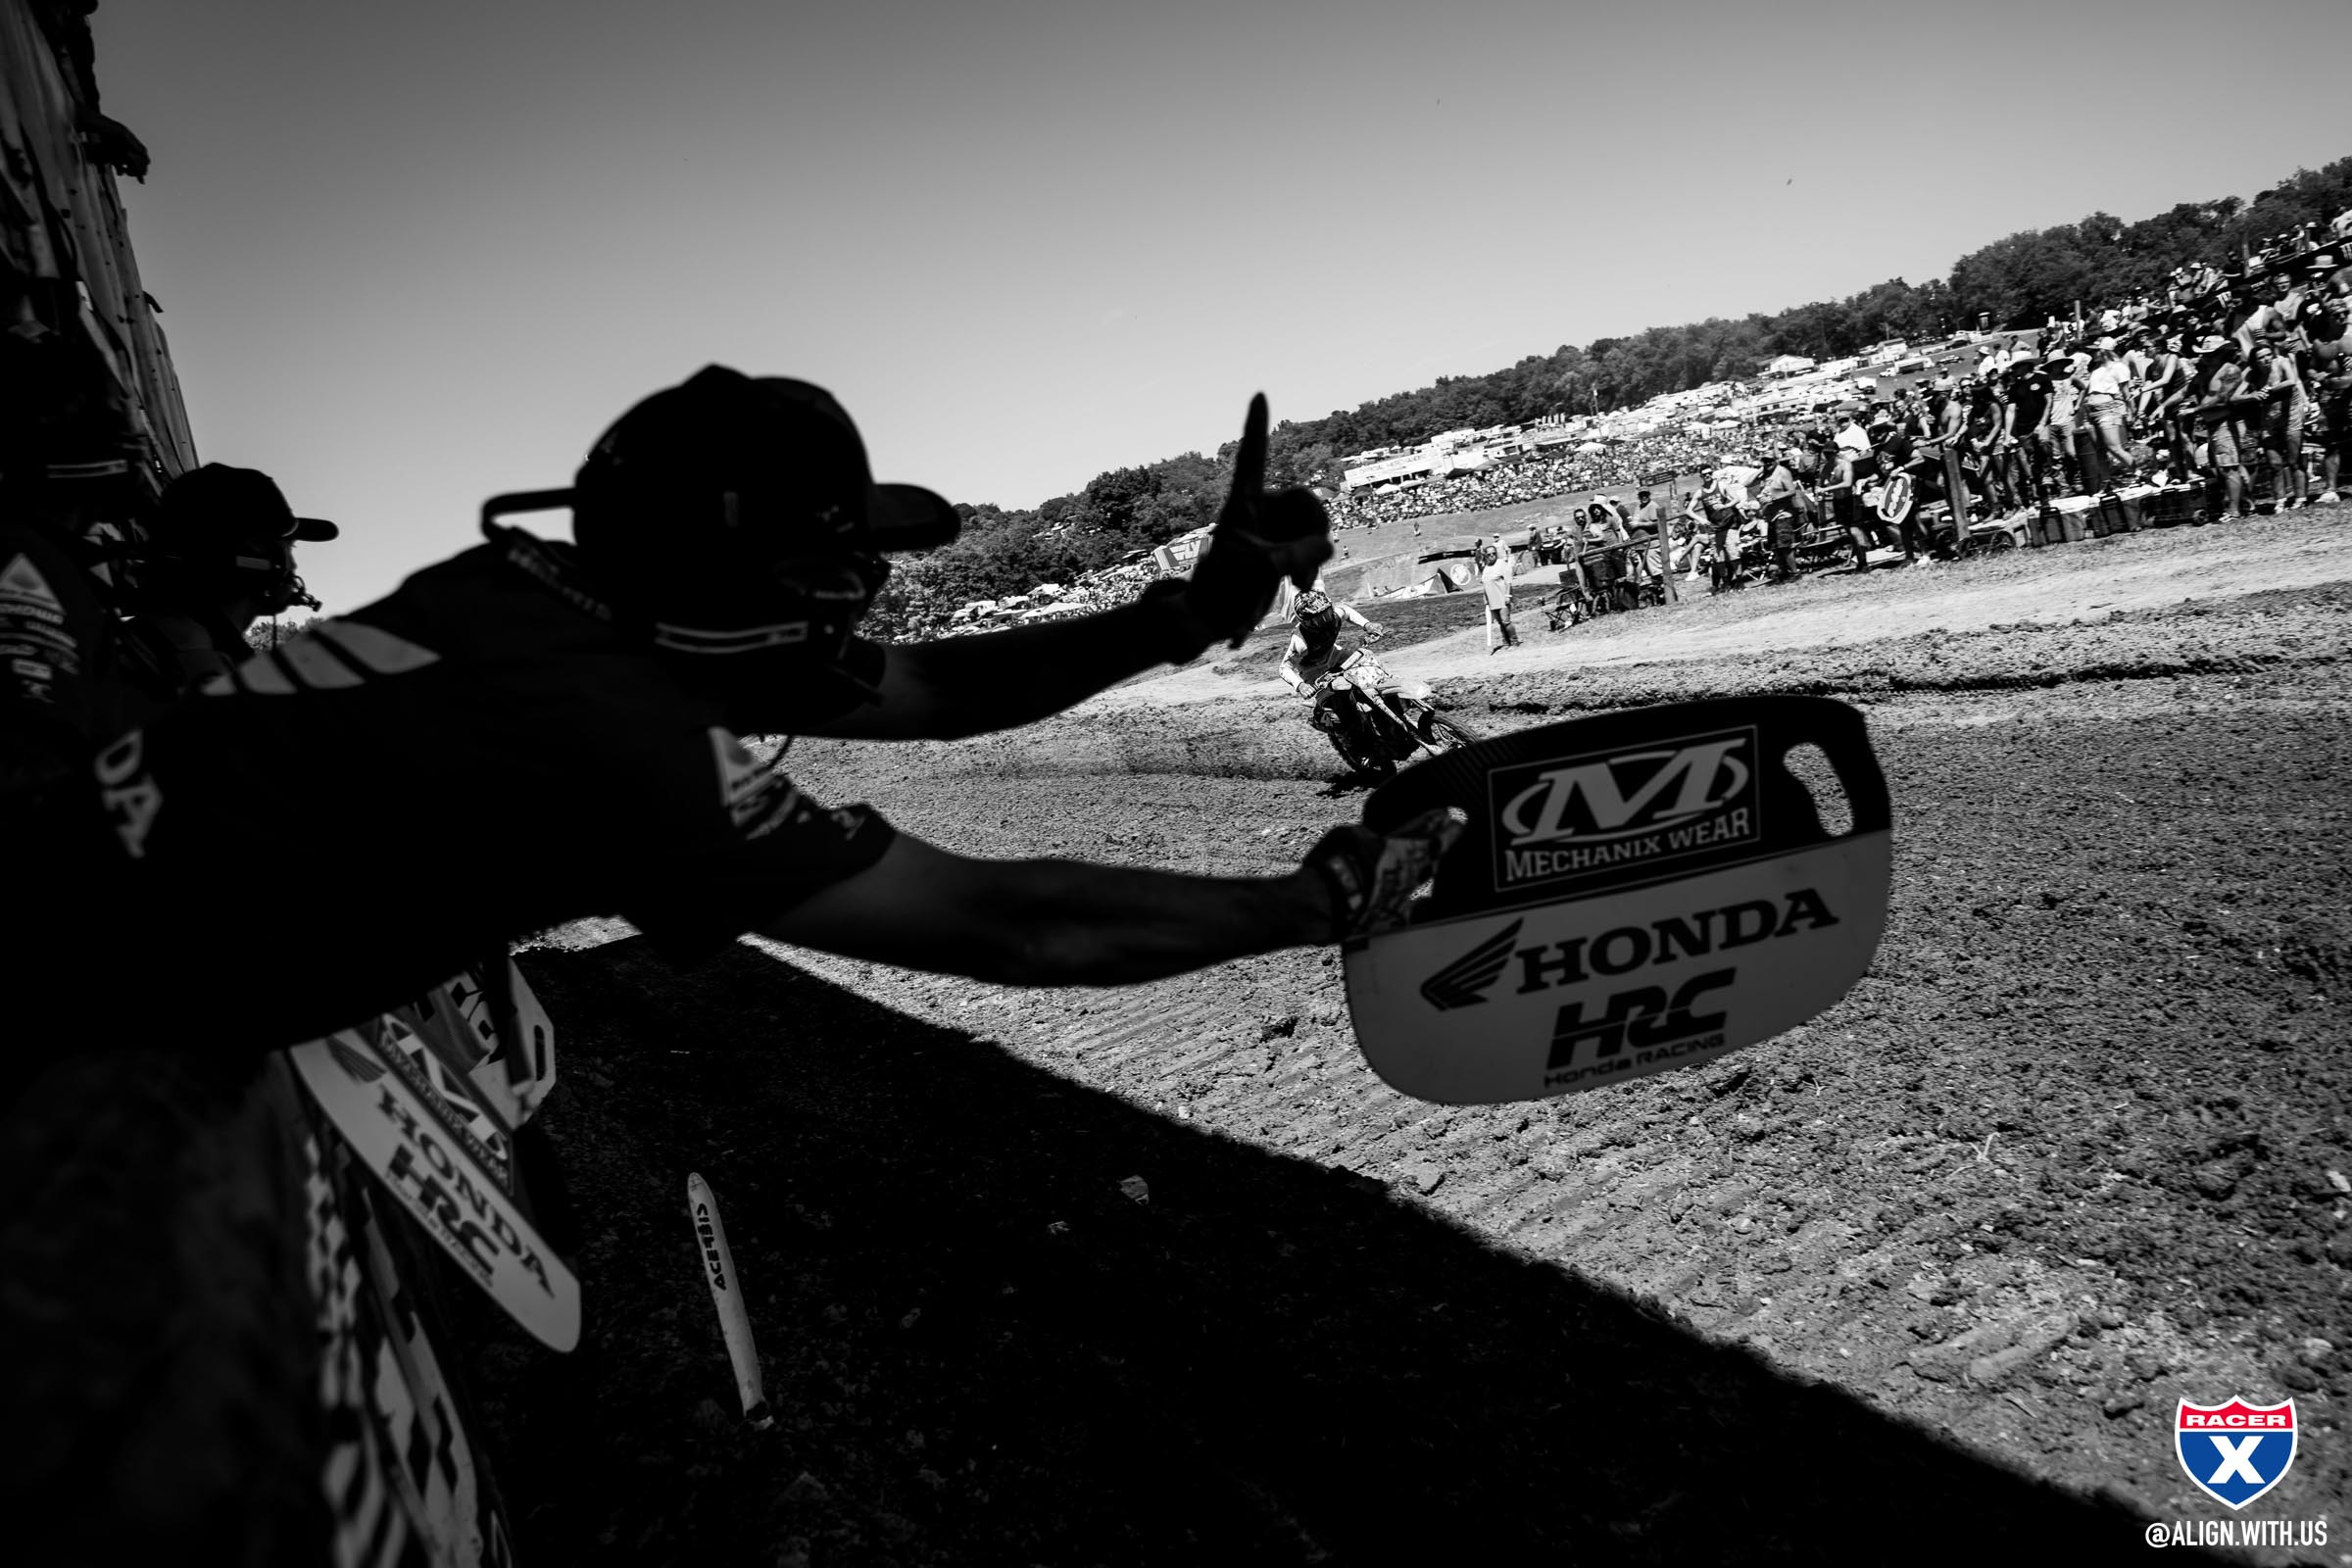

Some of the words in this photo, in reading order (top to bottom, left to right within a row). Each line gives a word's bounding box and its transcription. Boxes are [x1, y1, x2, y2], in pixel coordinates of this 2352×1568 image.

[1503, 835, 1662, 882] MECHANIX
[1668, 806, 1751, 851] WEAR
[1516, 888, 1839, 994] HONDA
[1544, 1057, 1631, 1088] Honda
[1636, 1033, 1727, 1065] RACING
[1546, 967, 1737, 1070] HRC
[376, 1080, 556, 1299] HONDA
[697, 1203, 726, 1291] ACERBIS
